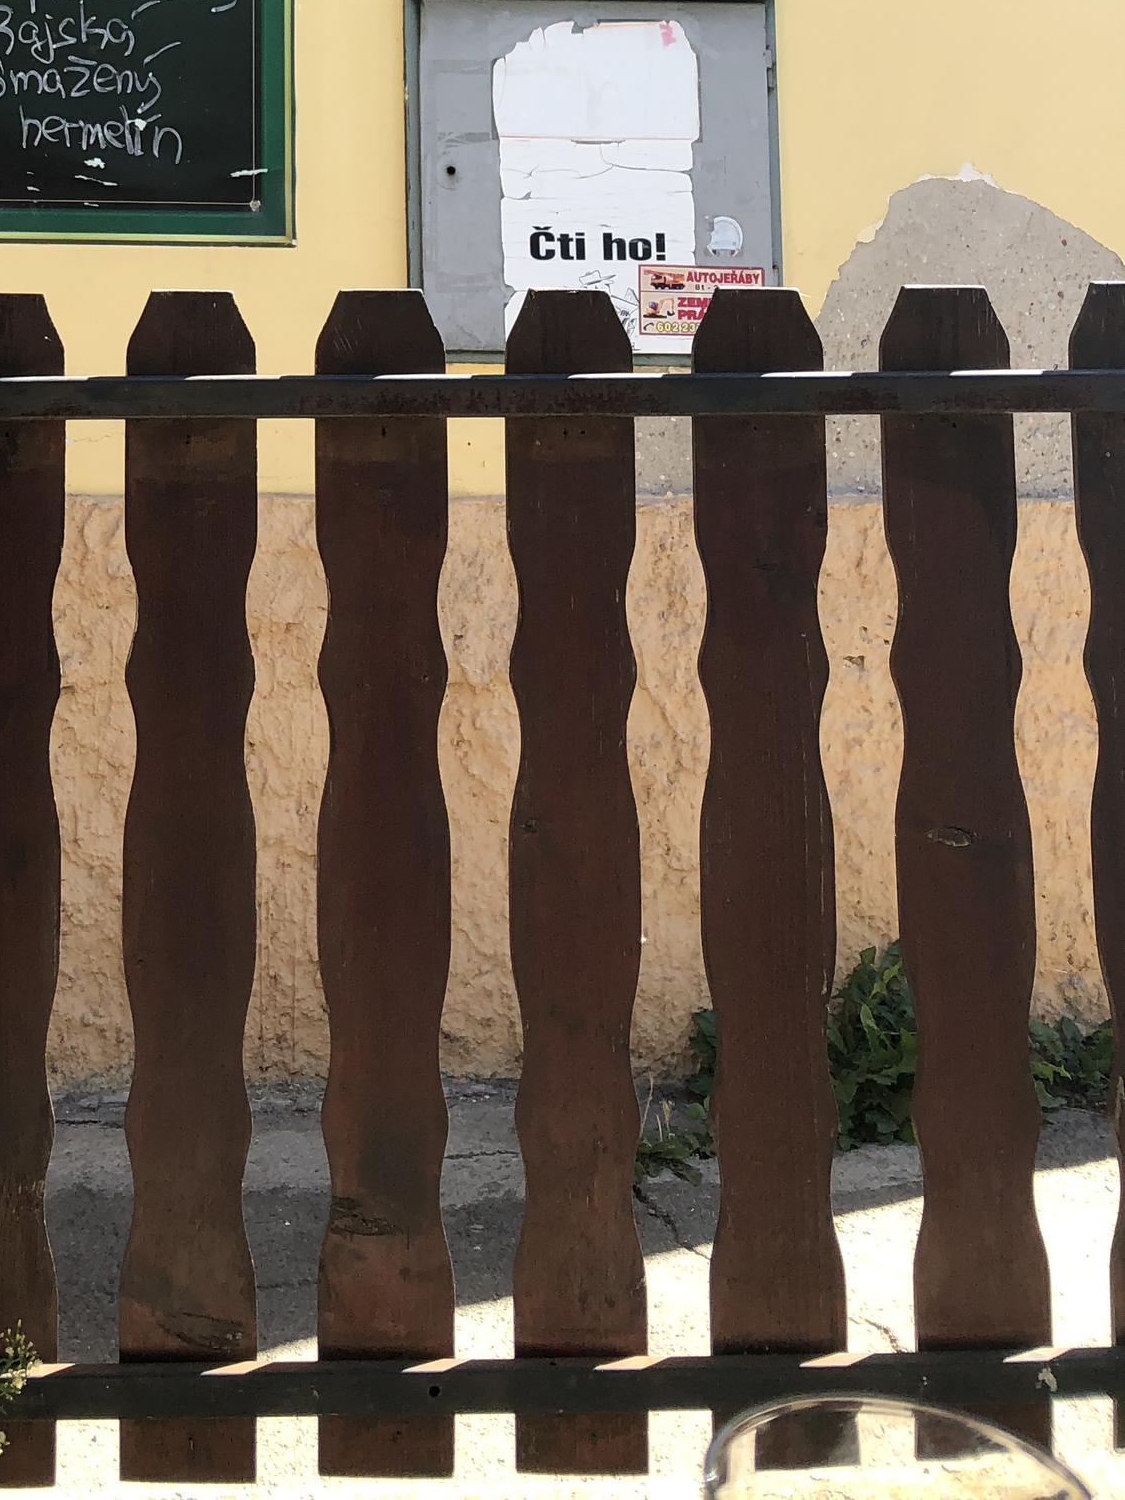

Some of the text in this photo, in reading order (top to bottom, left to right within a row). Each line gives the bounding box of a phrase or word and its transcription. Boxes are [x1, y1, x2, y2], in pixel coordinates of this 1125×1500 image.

[19, 104, 183, 164] hermelín
[530, 226, 666, 261] Čti ho!
[686, 269, 760, 285] AUTOJEŘÁBY
[677, 297, 712, 308] ZEM
[677, 308, 706, 320] PRÁ
[656, 322, 700, 333] 602 23
